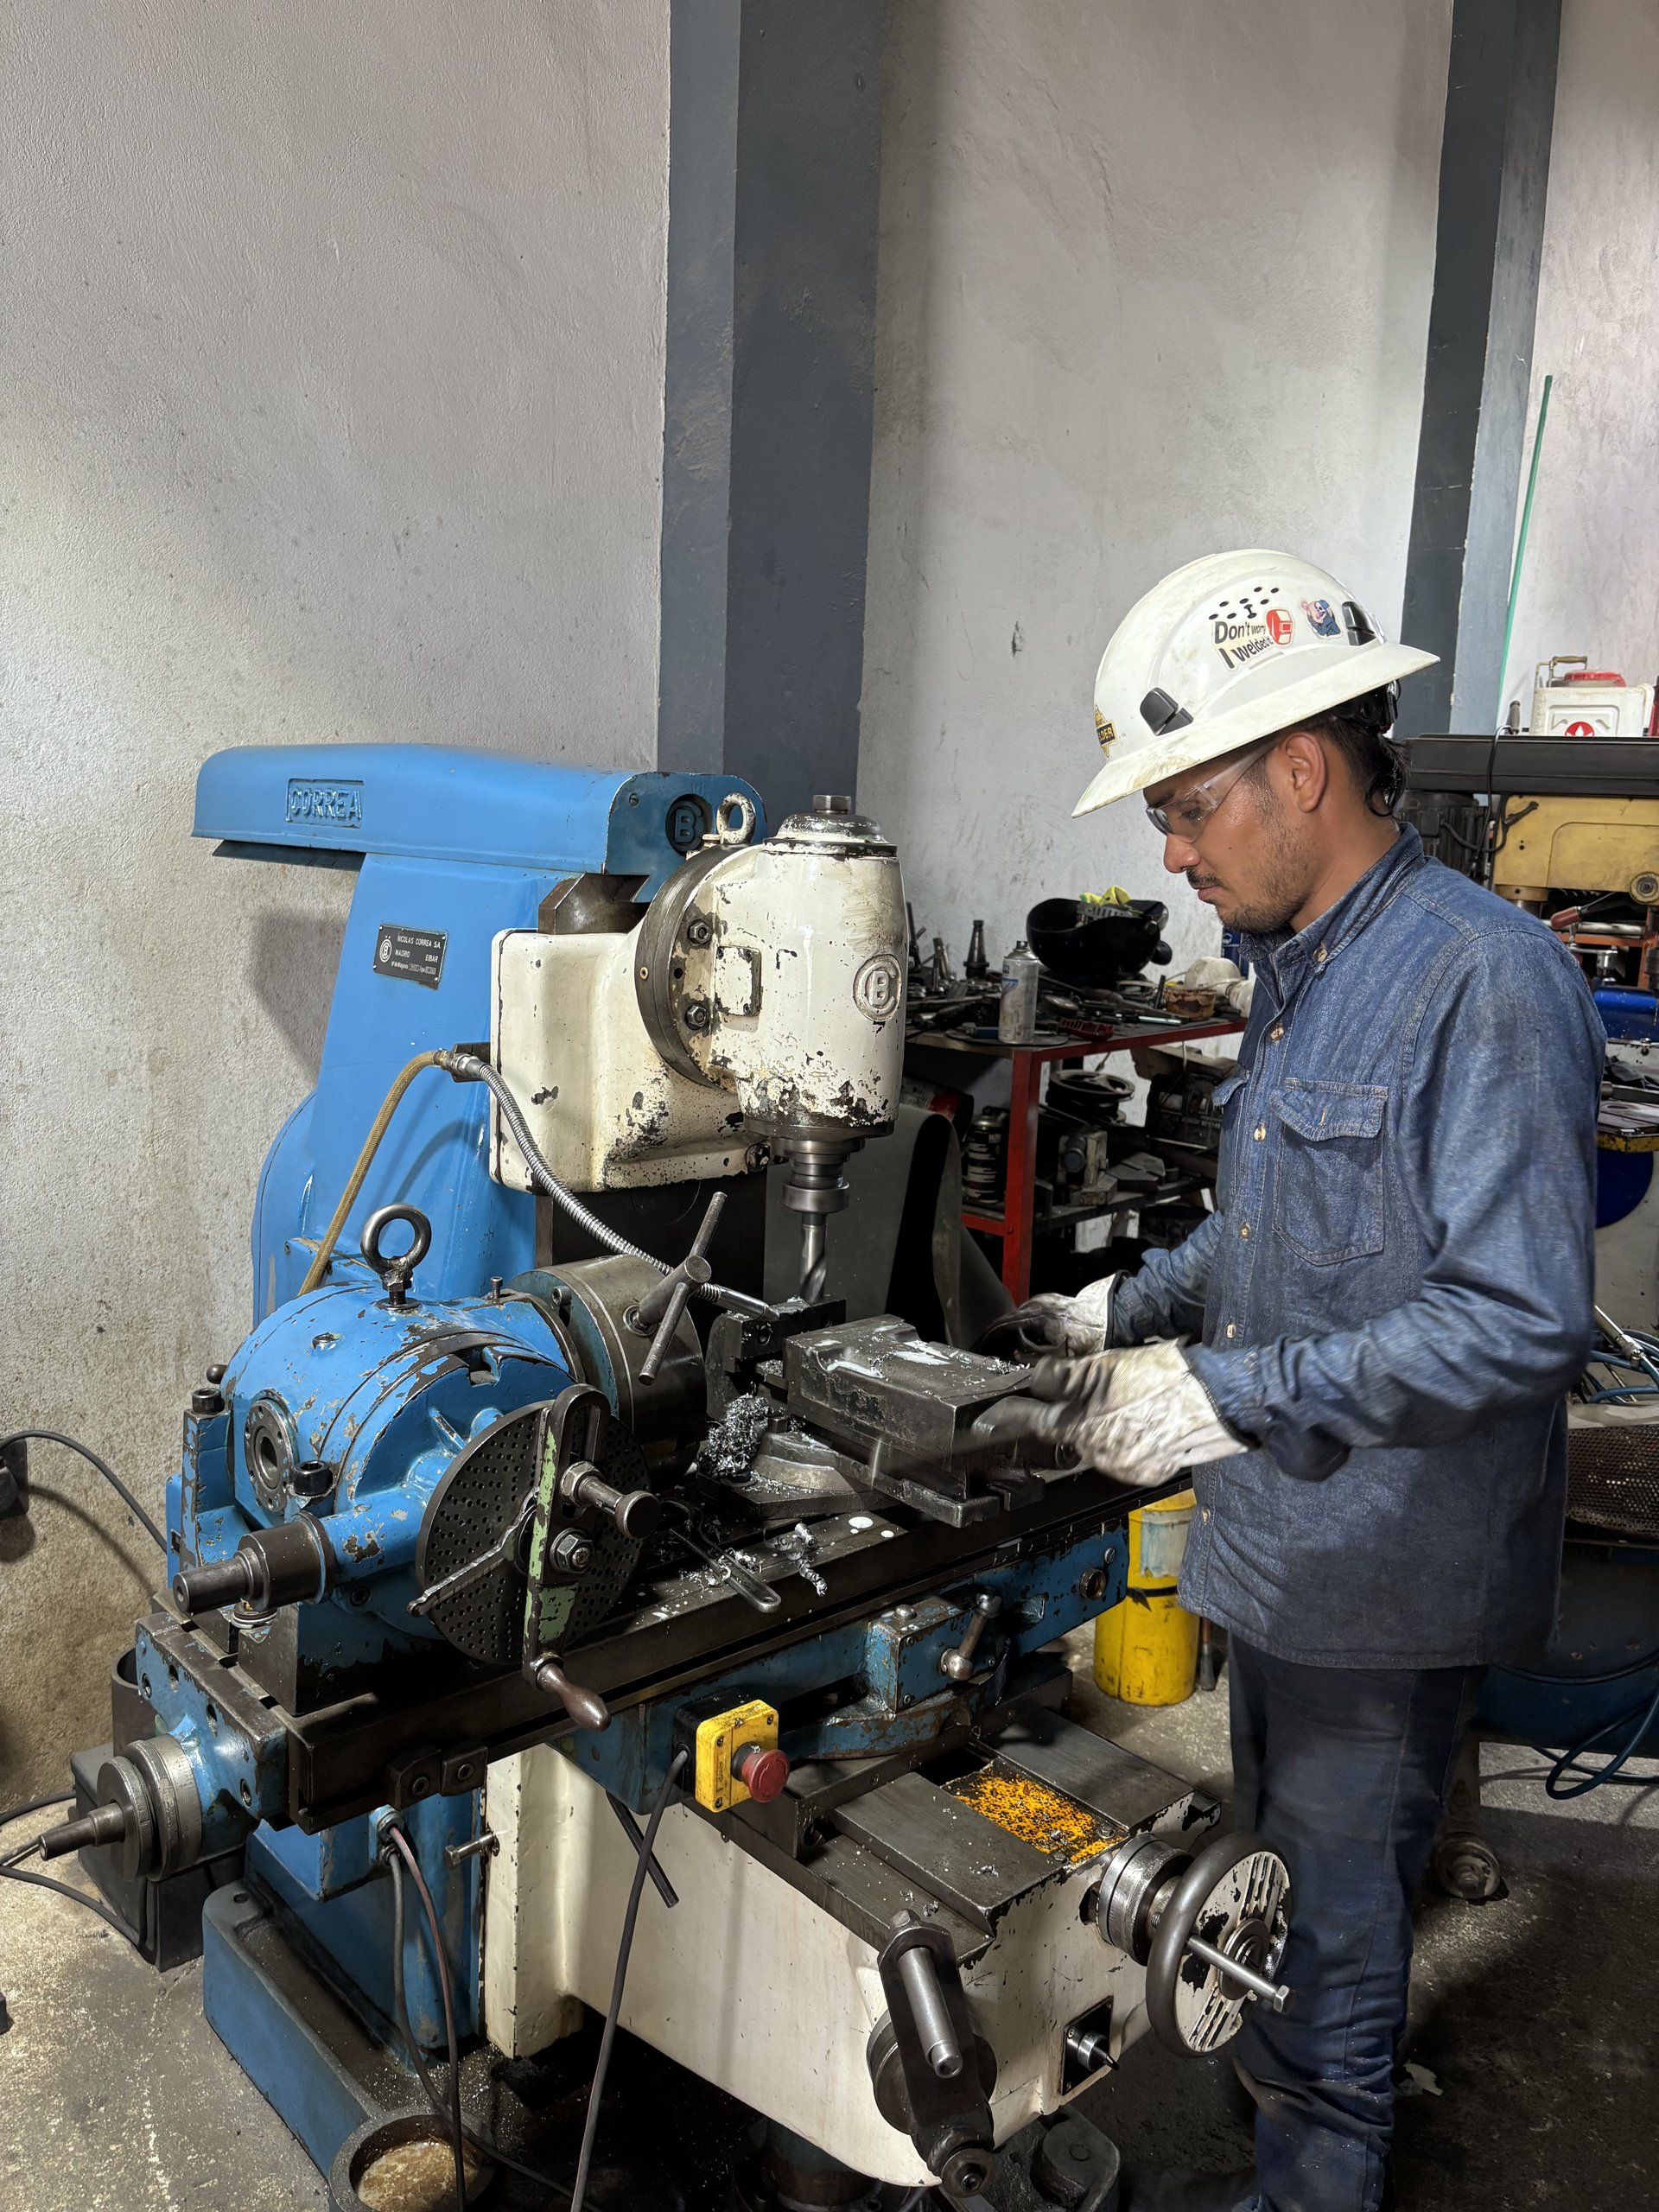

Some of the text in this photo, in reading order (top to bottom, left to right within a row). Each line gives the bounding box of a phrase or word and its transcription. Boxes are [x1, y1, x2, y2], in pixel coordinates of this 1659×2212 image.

[1215, 621, 1266, 644] Don't worry
[1218, 648, 1236, 669] I
[1230, 638, 1268, 663] welded
[1097, 727, 1113, 741] LDER
[290, 788, 362, 820] CORREA
[397, 935, 414, 944] NICOLAS
[416, 938, 432, 948] CORREA
[395, 950, 439, 963] MADRID EIBAR
